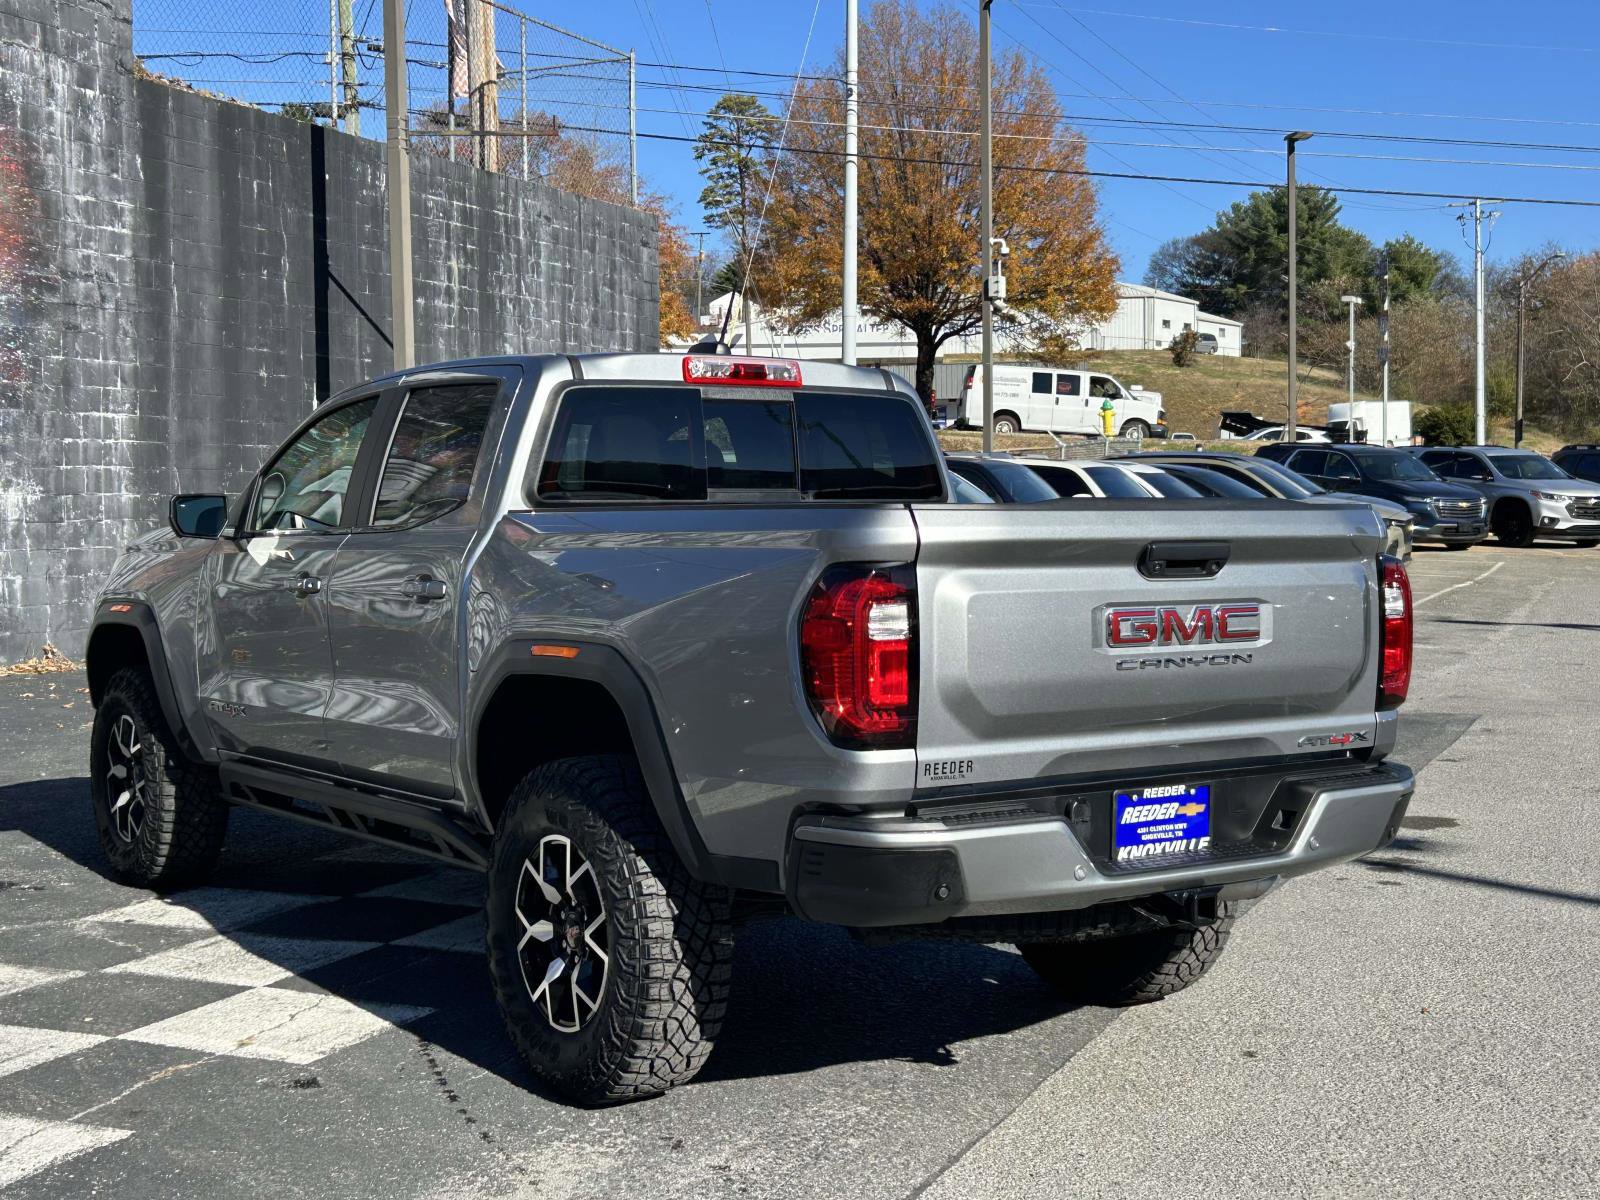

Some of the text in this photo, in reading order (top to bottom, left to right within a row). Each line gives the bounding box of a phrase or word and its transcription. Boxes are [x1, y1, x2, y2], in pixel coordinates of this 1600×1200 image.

[1106, 603, 1261, 648] GMC
[1116, 653, 1252, 671] CANYON
[924, 760, 973, 776] REEDER
[1143, 785, 1186, 799] REEDER
[1121, 802, 1180, 824] REEDER
